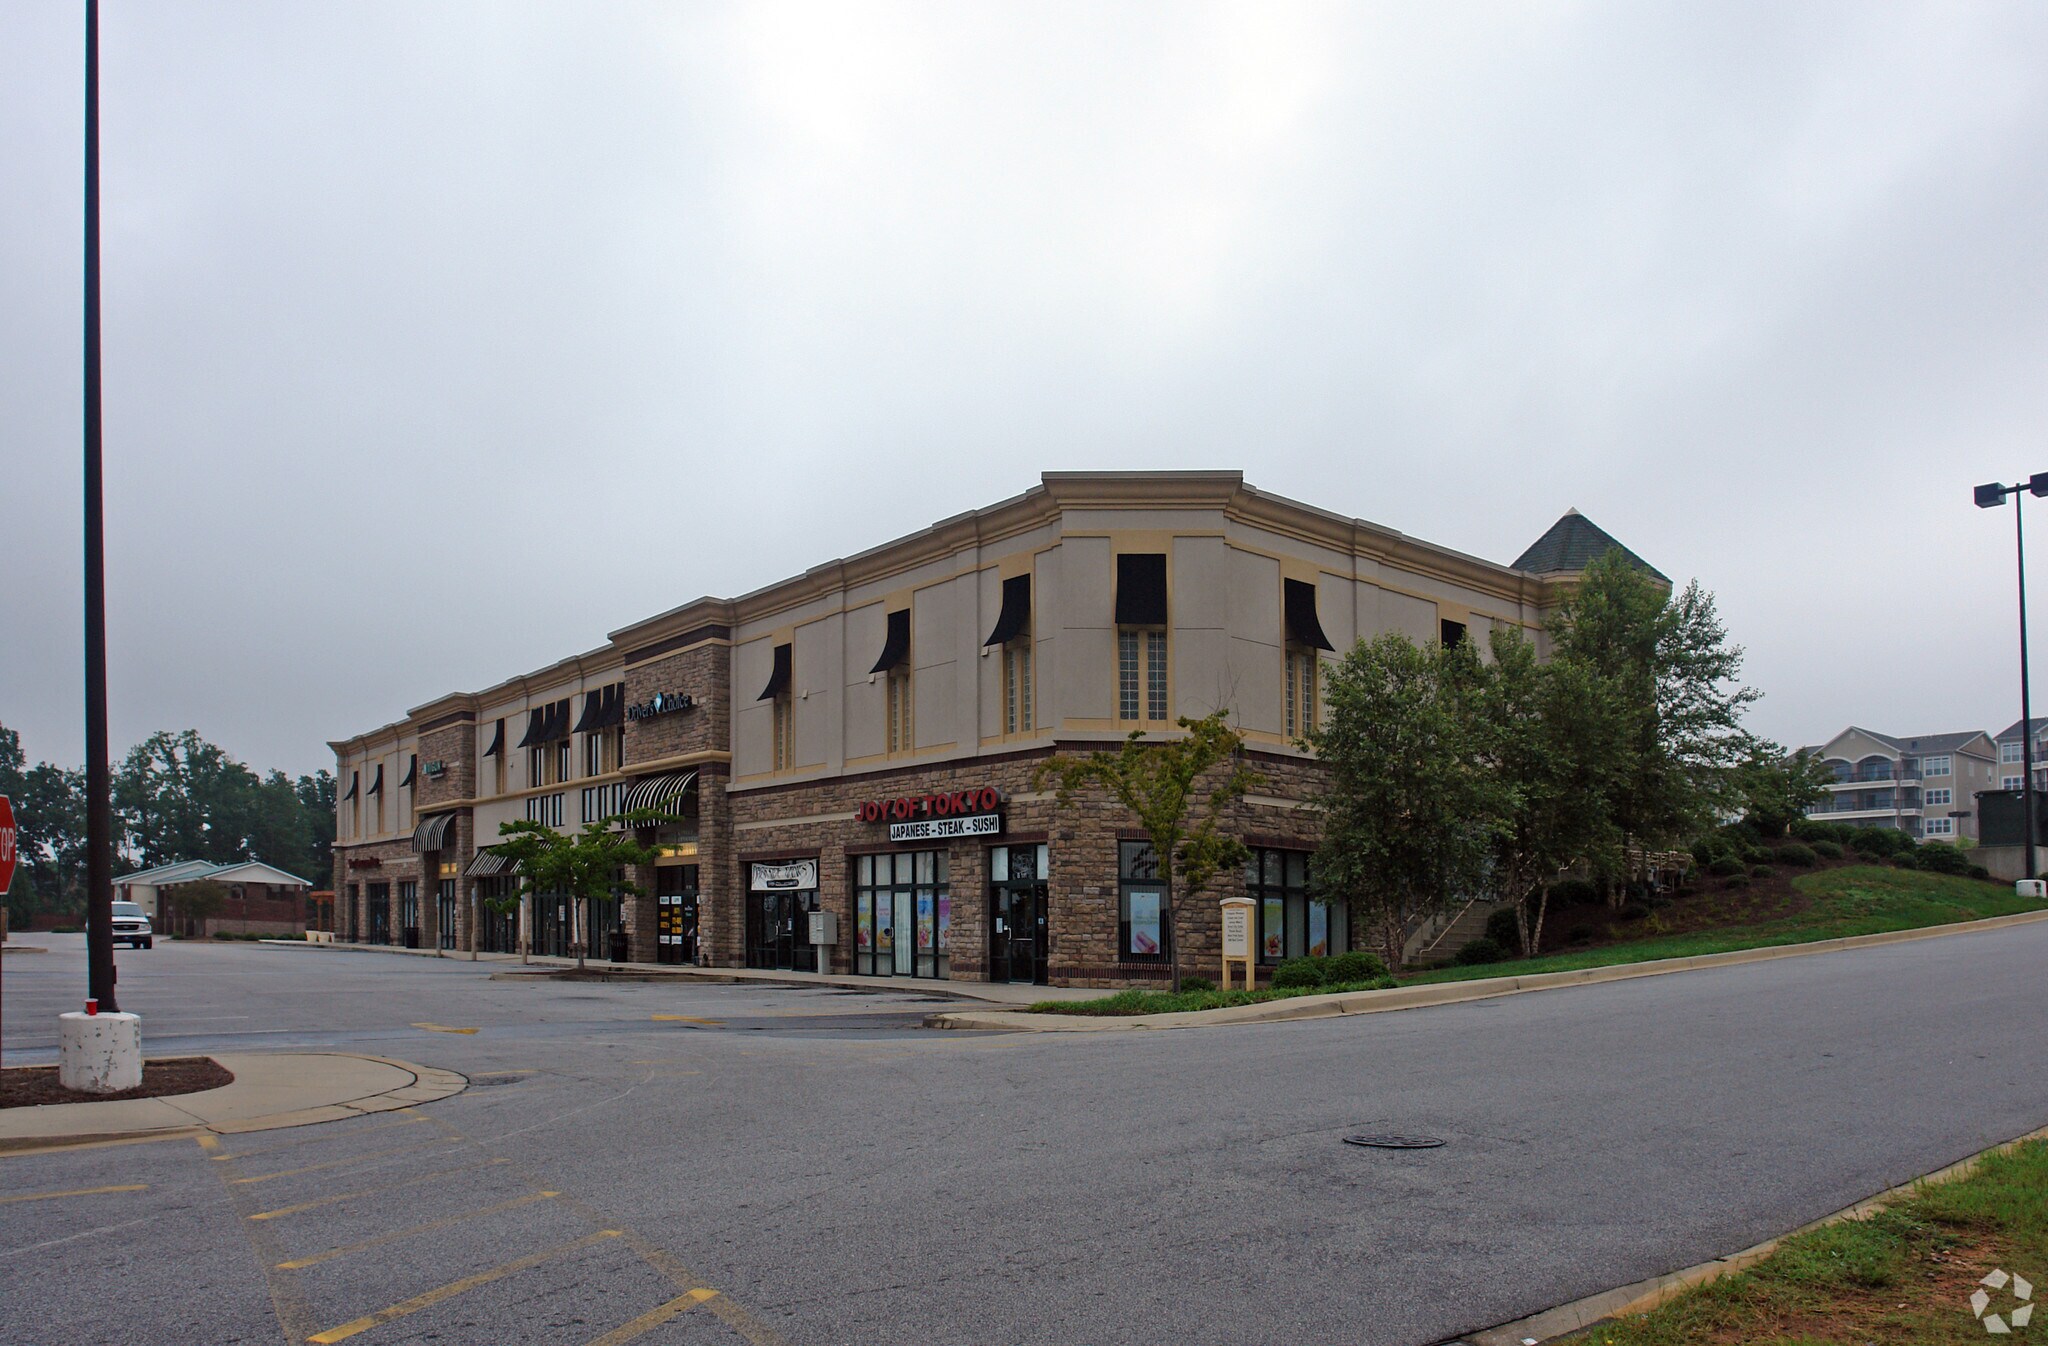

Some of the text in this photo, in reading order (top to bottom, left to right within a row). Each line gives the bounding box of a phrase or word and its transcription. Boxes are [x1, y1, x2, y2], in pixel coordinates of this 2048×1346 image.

[661, 692, 690, 713] Choice
[855, 787, 999, 822] JOY OF TOKYO
[891, 823, 930, 839] JAPANESE
[938, 820, 965, 836] STEAK
[972, 816, 998, 833] SUSHI
[0, 827, 15, 862] OP
